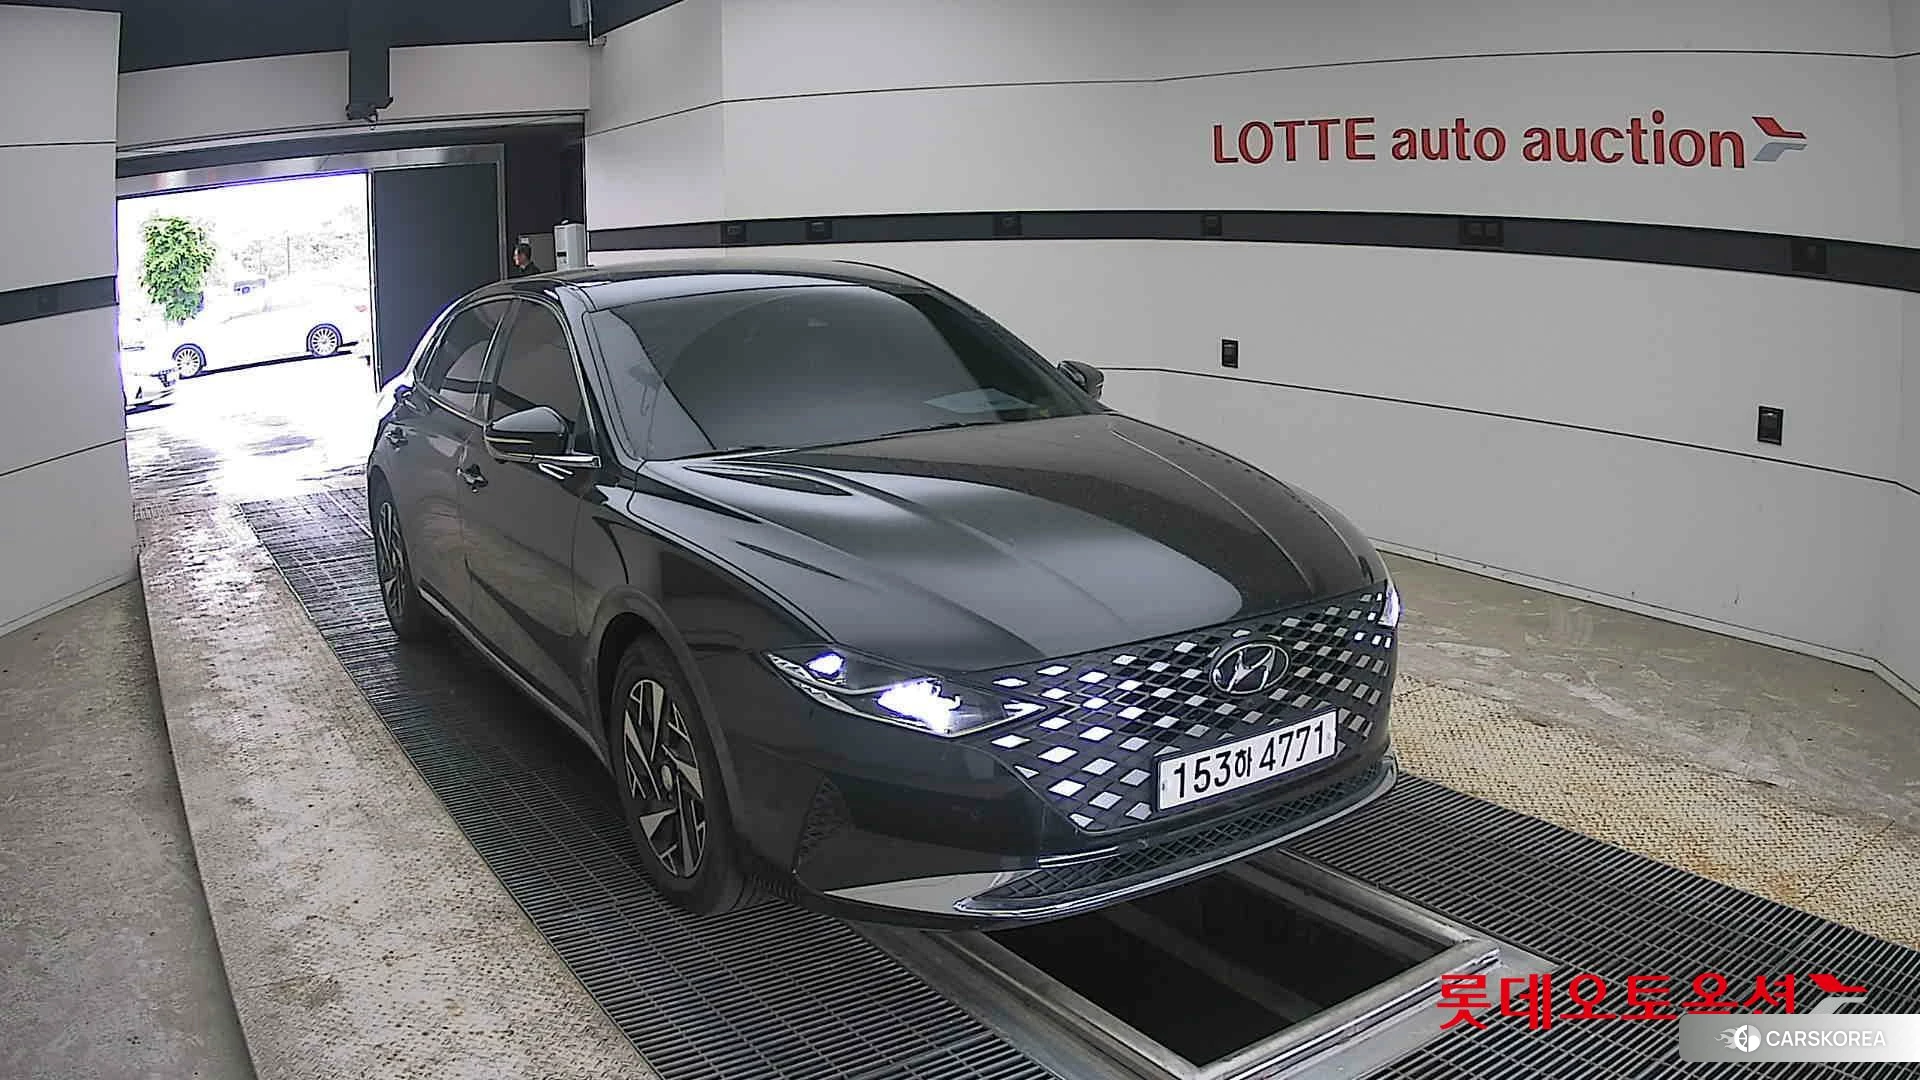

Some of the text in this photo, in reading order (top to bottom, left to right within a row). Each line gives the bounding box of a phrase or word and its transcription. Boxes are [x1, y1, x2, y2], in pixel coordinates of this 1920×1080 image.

[1213, 109, 1746, 169] LOTTE auto auction
[1173, 720, 1324, 799] 153하 4771
